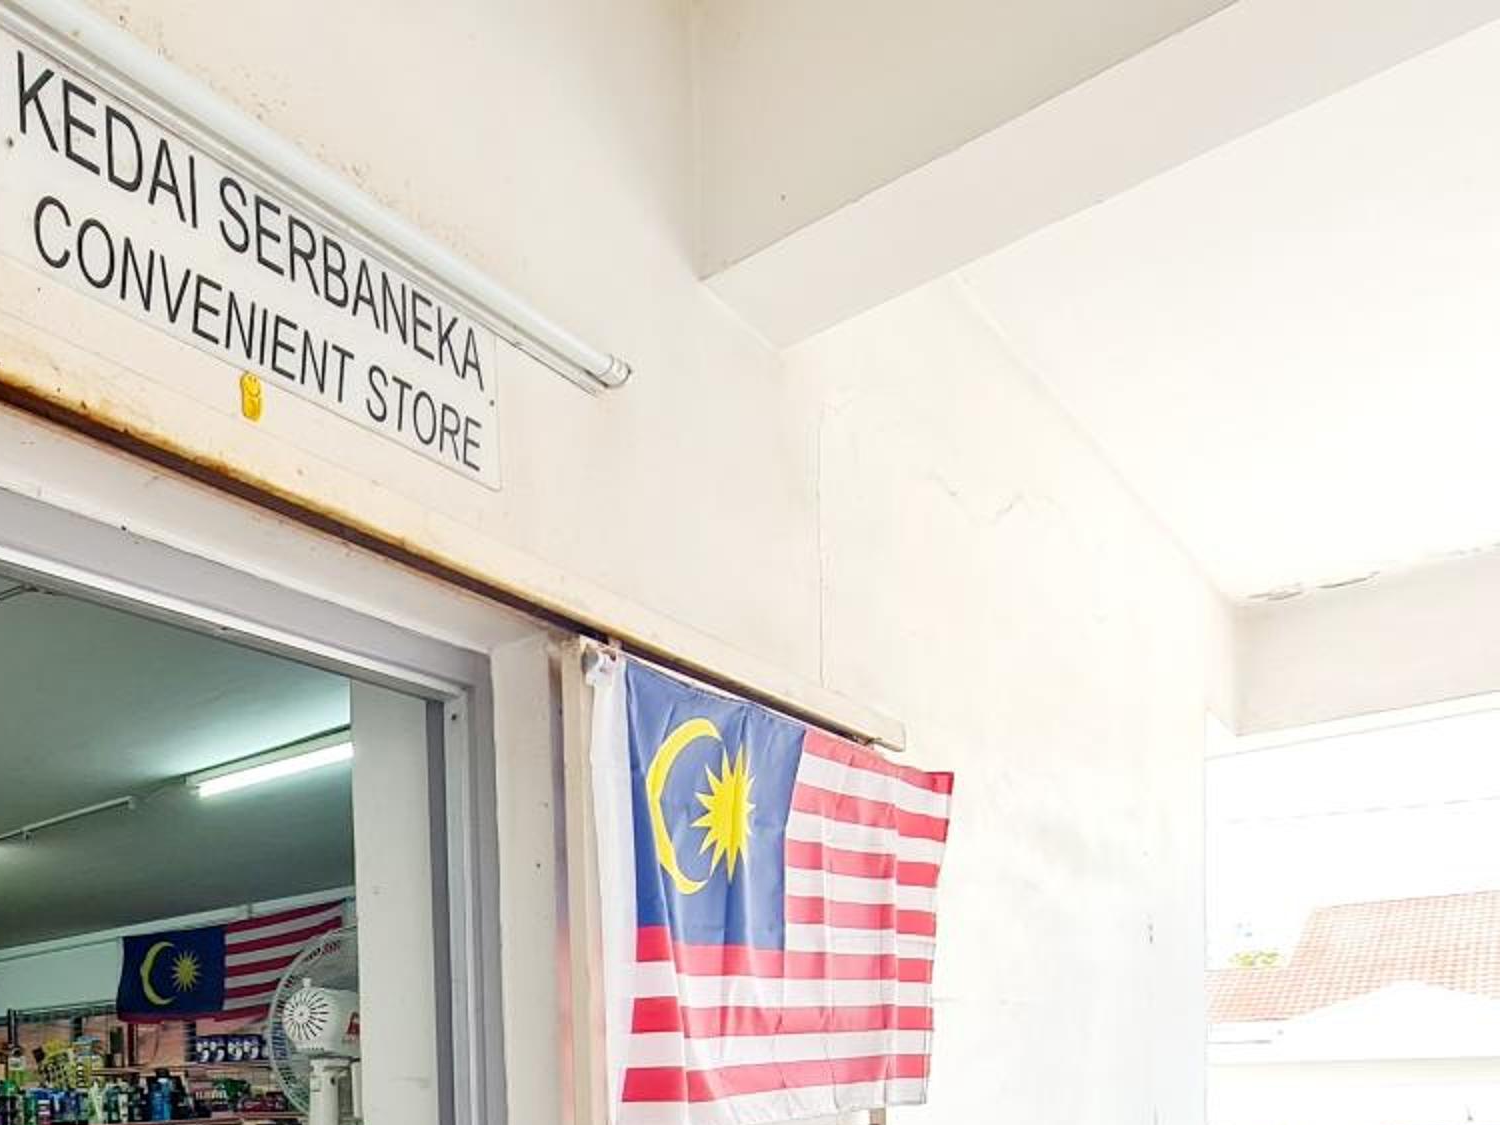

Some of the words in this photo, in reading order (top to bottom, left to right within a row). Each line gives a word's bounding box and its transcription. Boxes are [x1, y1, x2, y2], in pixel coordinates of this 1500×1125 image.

[15, 50, 199, 230] KEDAI
[218, 176, 485, 391] SERBANEKA
[33, 195, 356, 404] CONVENIENT
[365, 365, 483, 472] STORE
